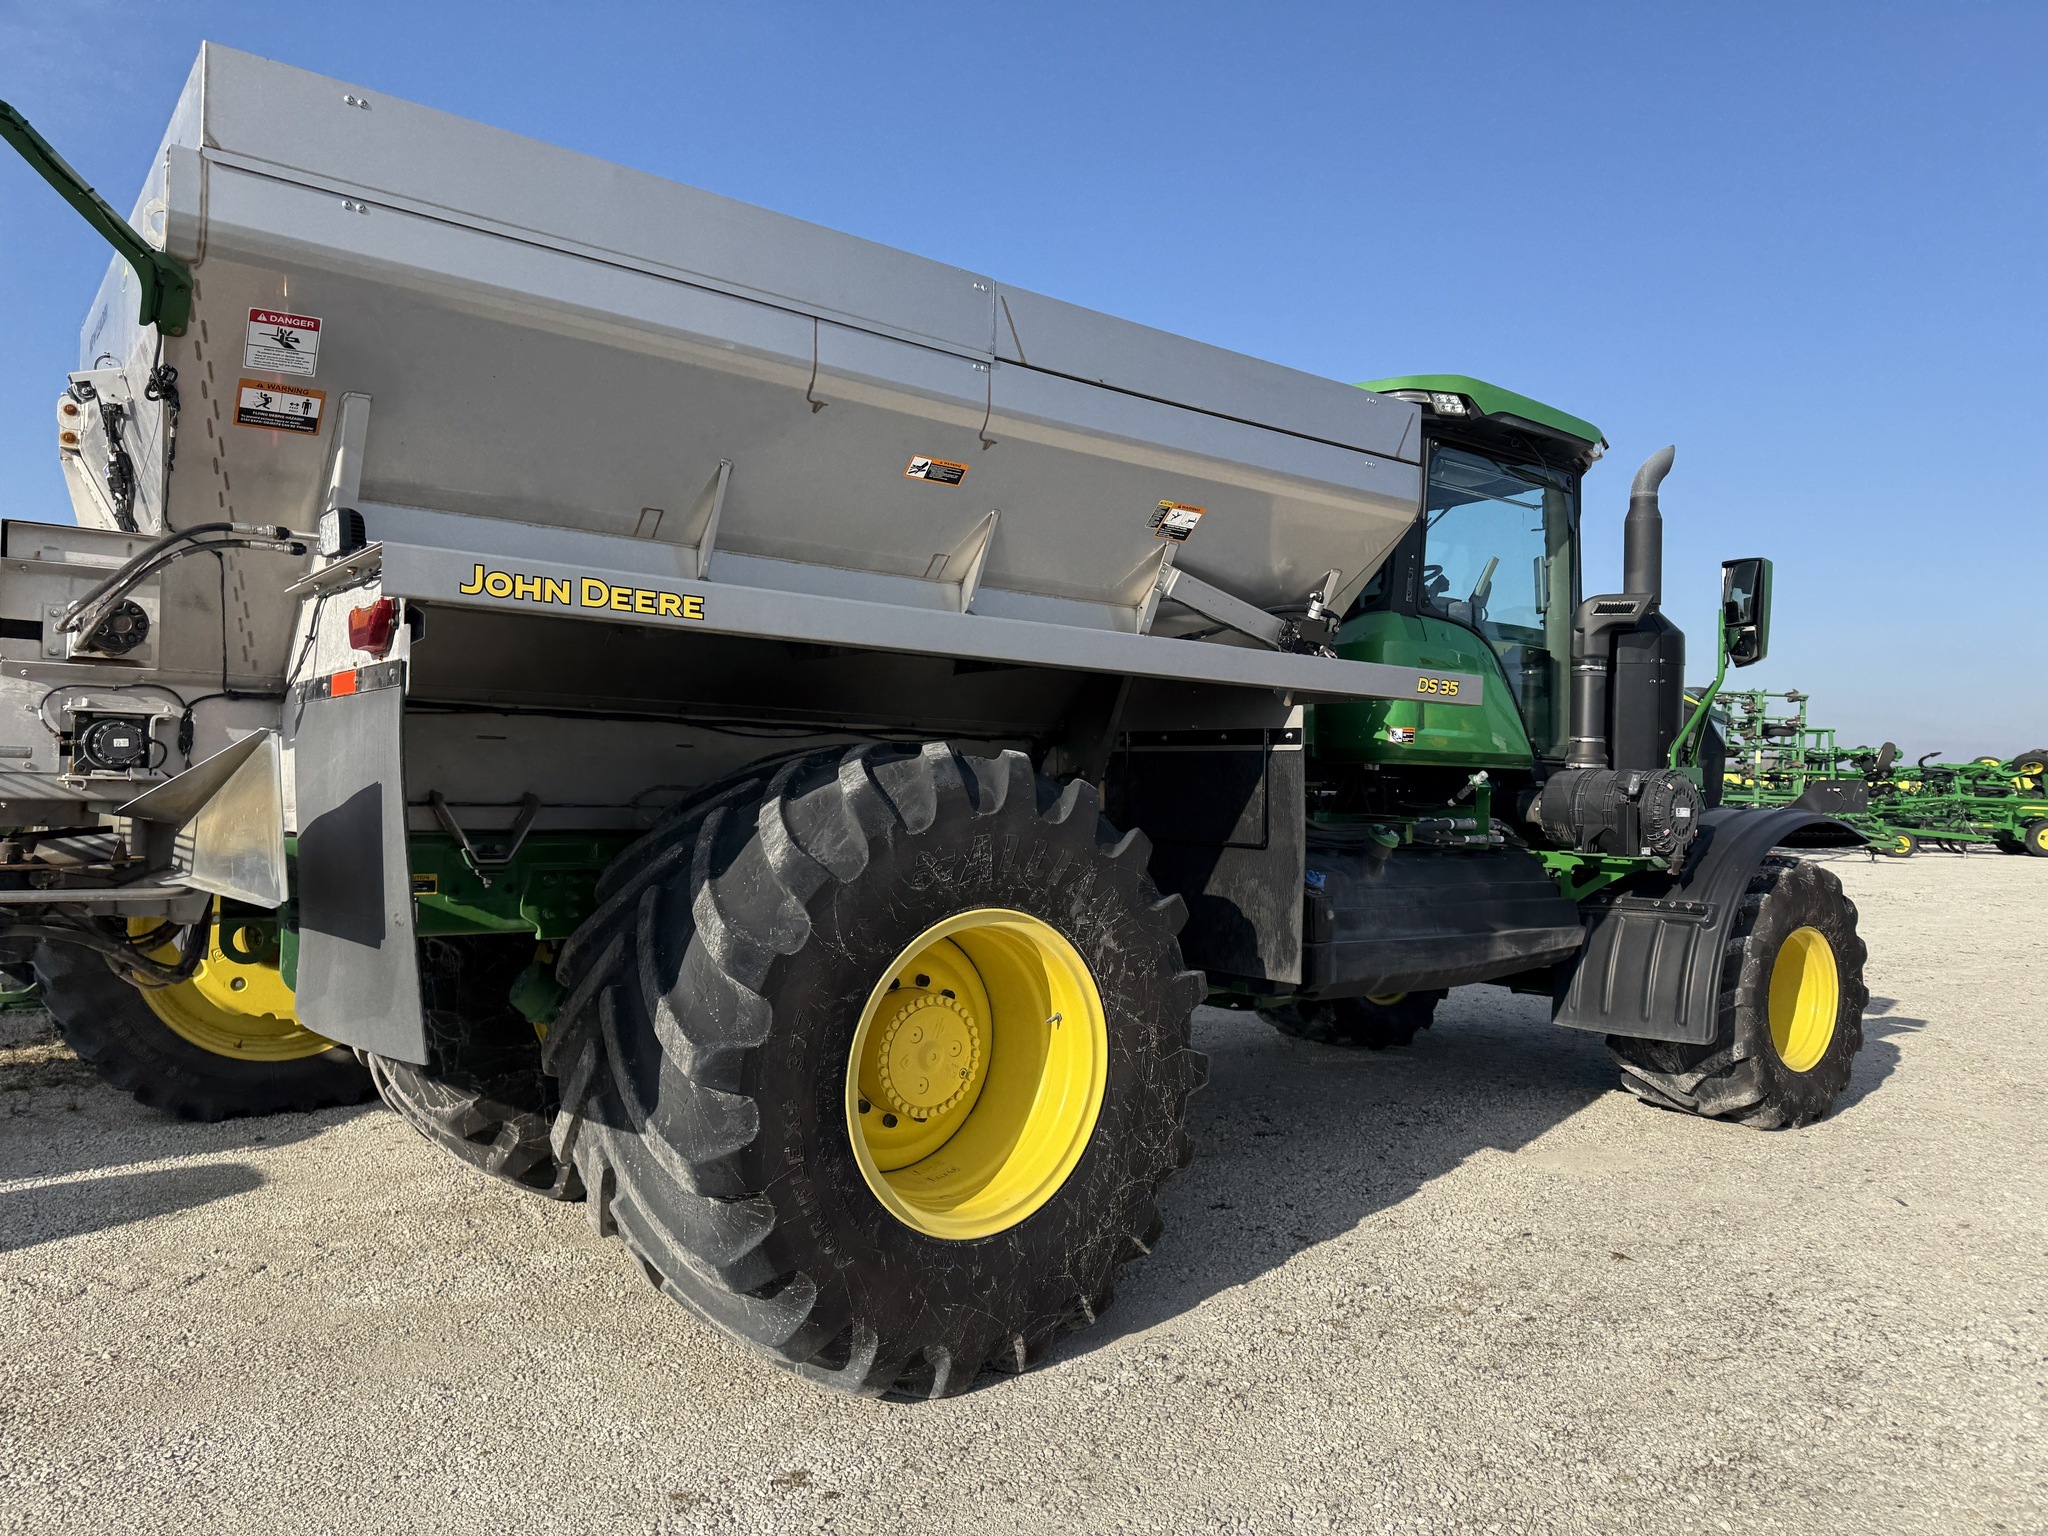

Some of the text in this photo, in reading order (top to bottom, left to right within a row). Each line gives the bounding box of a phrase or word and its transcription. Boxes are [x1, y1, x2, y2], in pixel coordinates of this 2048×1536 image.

[270, 315, 314, 328] DANGER
[267, 383, 309, 395] WARNING
[459, 563, 705, 620] JOHN DEERE
[1417, 676, 1460, 696] DS 35
